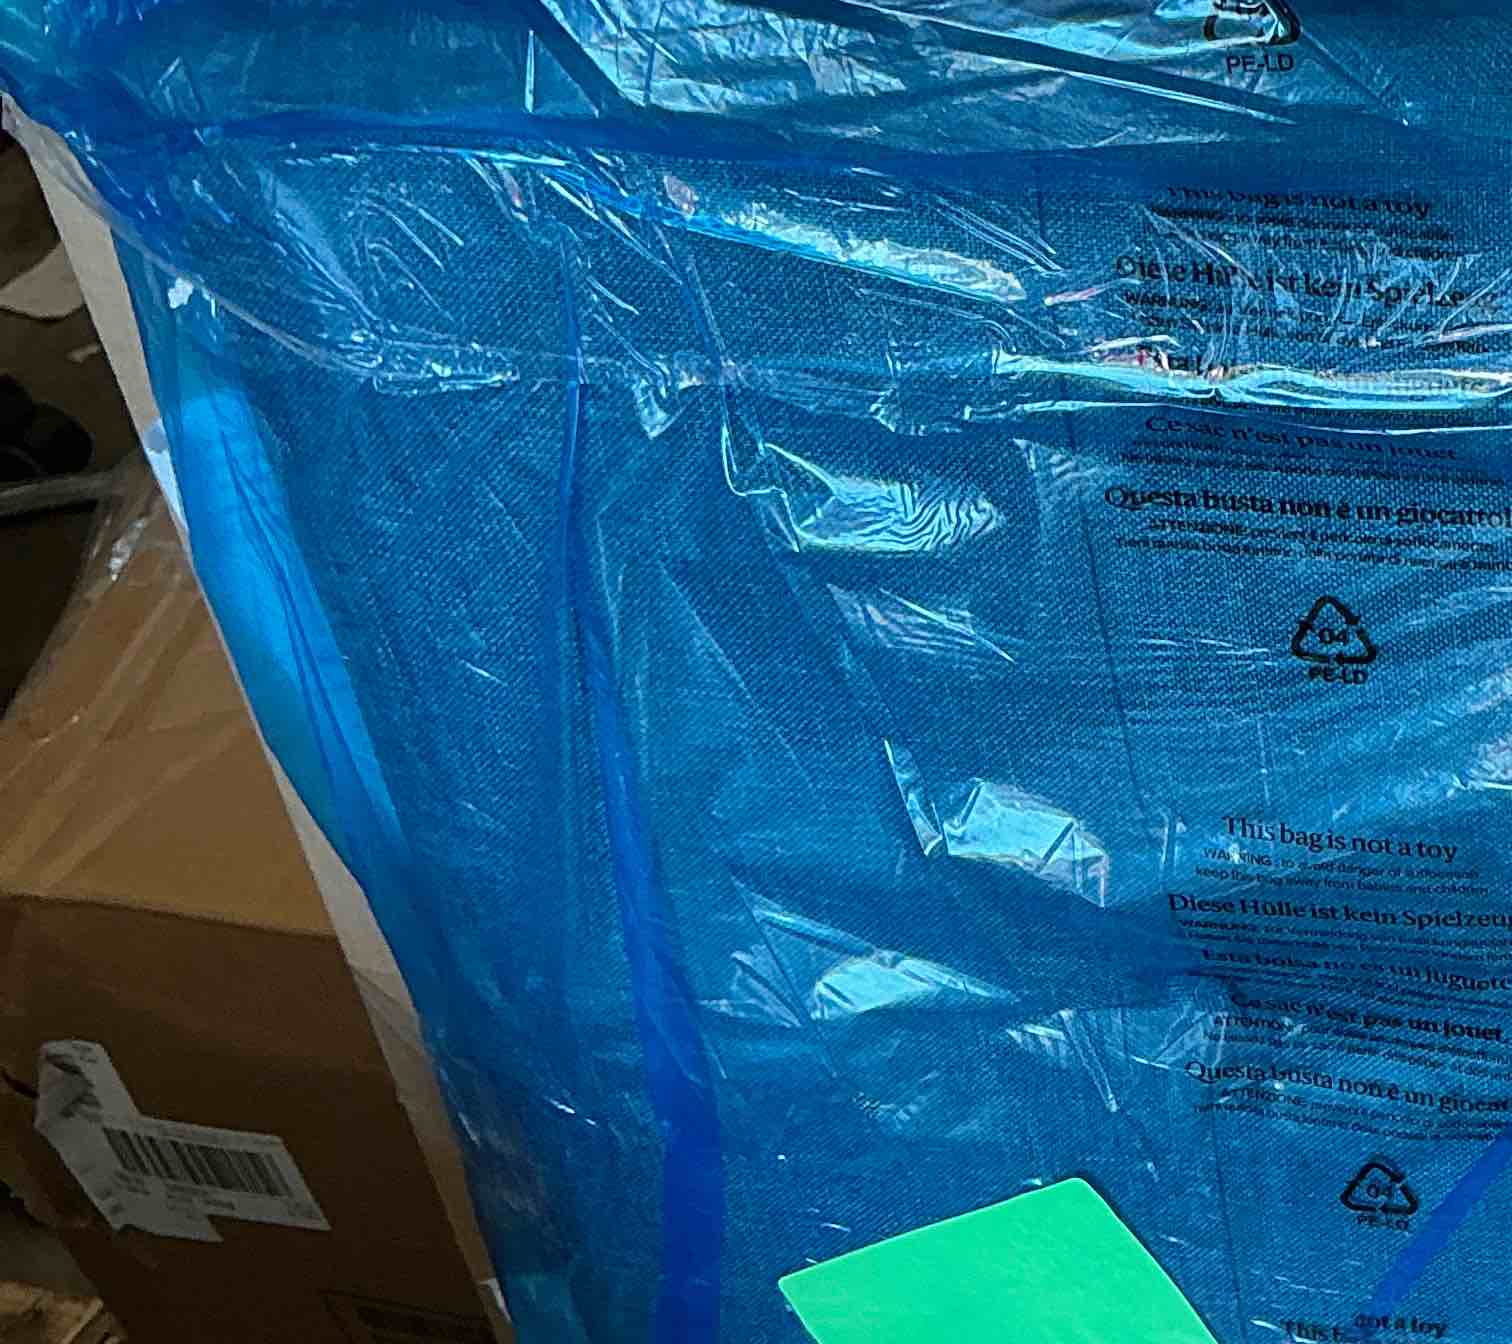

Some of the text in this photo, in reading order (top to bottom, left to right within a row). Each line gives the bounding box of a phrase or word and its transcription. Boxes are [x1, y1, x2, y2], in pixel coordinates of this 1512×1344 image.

[1225, 52, 1295, 75] PE-LD
[1103, 486, 1198, 513] Questa
[1202, 490, 1276, 516] busta
[1279, 499, 1332, 518] non
[1354, 503, 1394, 522] un
[1319, 628, 1349, 645] 04
[1223, 815, 1458, 864] This bag is not a toy
[1168, 892, 1236, 916] Diese
[1310, 902, 1341, 923] ist
[1343, 904, 1399, 926] kein
[1183, 1059, 1266, 1085] Questa
[1267, 1066, 1334, 1090] busta
[1403, 1087, 1435, 1106] un
